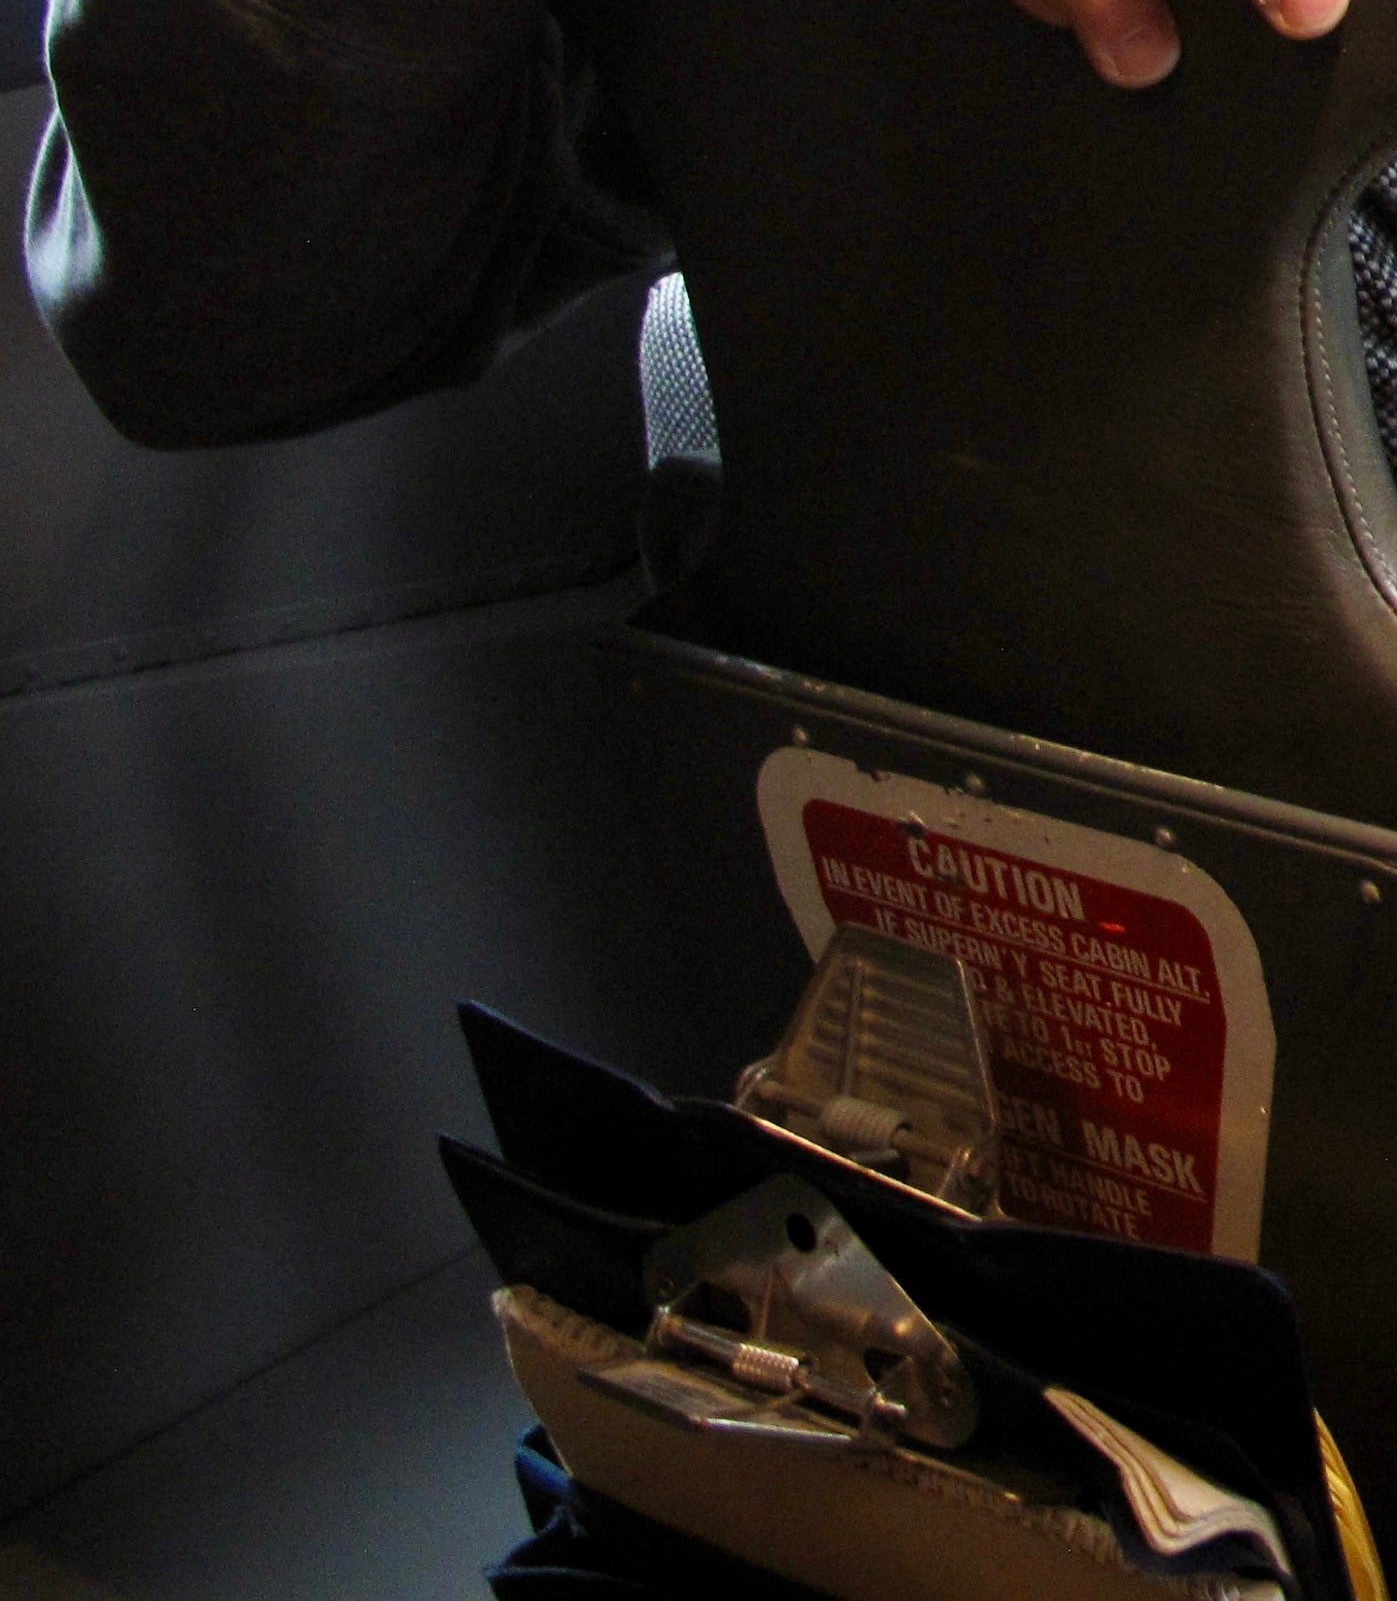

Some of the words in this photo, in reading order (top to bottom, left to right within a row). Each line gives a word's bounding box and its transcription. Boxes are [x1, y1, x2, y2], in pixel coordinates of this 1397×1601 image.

[908, 836, 1086, 920] CAUTION
[821, 855, 844, 888] IN
[855, 867, 930, 911] EVENT
[935, 891, 966, 923] OF
[971, 901, 1068, 955] EXCESS
[1070, 932, 1153, 980] CABIN
[874, 906, 898, 936] IF
[1110, 980, 1183, 1028] FULLY
[1002, 1035, 1101, 1088] ACCESS
[1105, 1069, 1145, 1104] TO
[1017, 1009, 1050, 1043] TO
[1099, 1036, 1173, 1081] STOP
[1049, 1160, 1153, 1217] HANDLE
[1081, 1119, 1202, 1195] MASK
[1040, 1184, 1141, 1241] ROTATE
